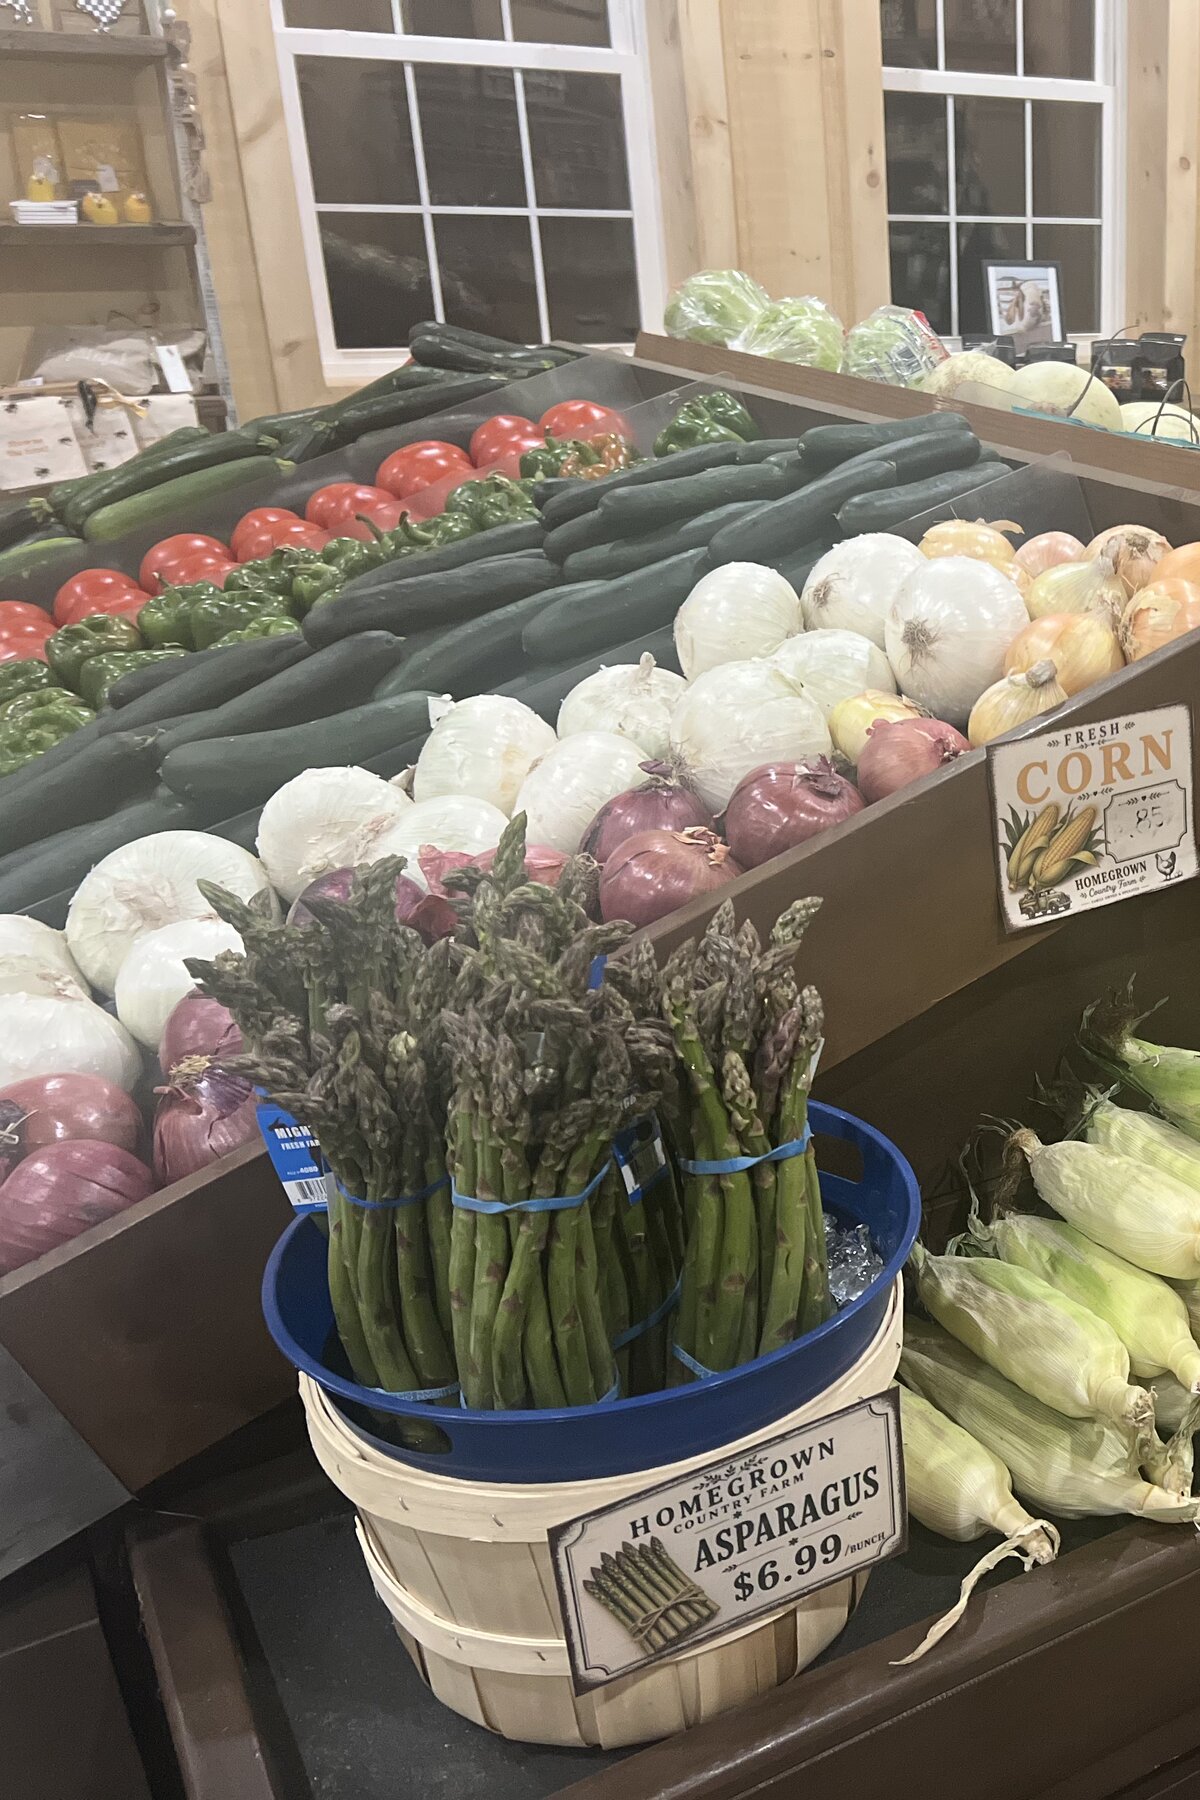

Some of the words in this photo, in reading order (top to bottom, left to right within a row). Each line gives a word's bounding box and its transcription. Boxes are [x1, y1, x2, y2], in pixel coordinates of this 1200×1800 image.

[1064, 722, 1120, 747] FRESH
[1016, 729, 1174, 805] CORN
[1074, 860, 1147, 891] HOMEGROWN
[1088, 884, 1117, 898] Country
[1118, 879, 1137, 890] Farm
[274, 1125, 312, 1140] MIGH
[280, 1140, 306, 1151] FRESH
[306, 1139, 321, 1148] FAR
[629, 1438, 835, 1540] HOMEGROWN
[673, 1493, 752, 1534] COUNTRY
[760, 1473, 805, 1498] FARM
[694, 1465, 880, 1573] ASPARAGUS
[733, 1533, 843, 1602] $6.99
